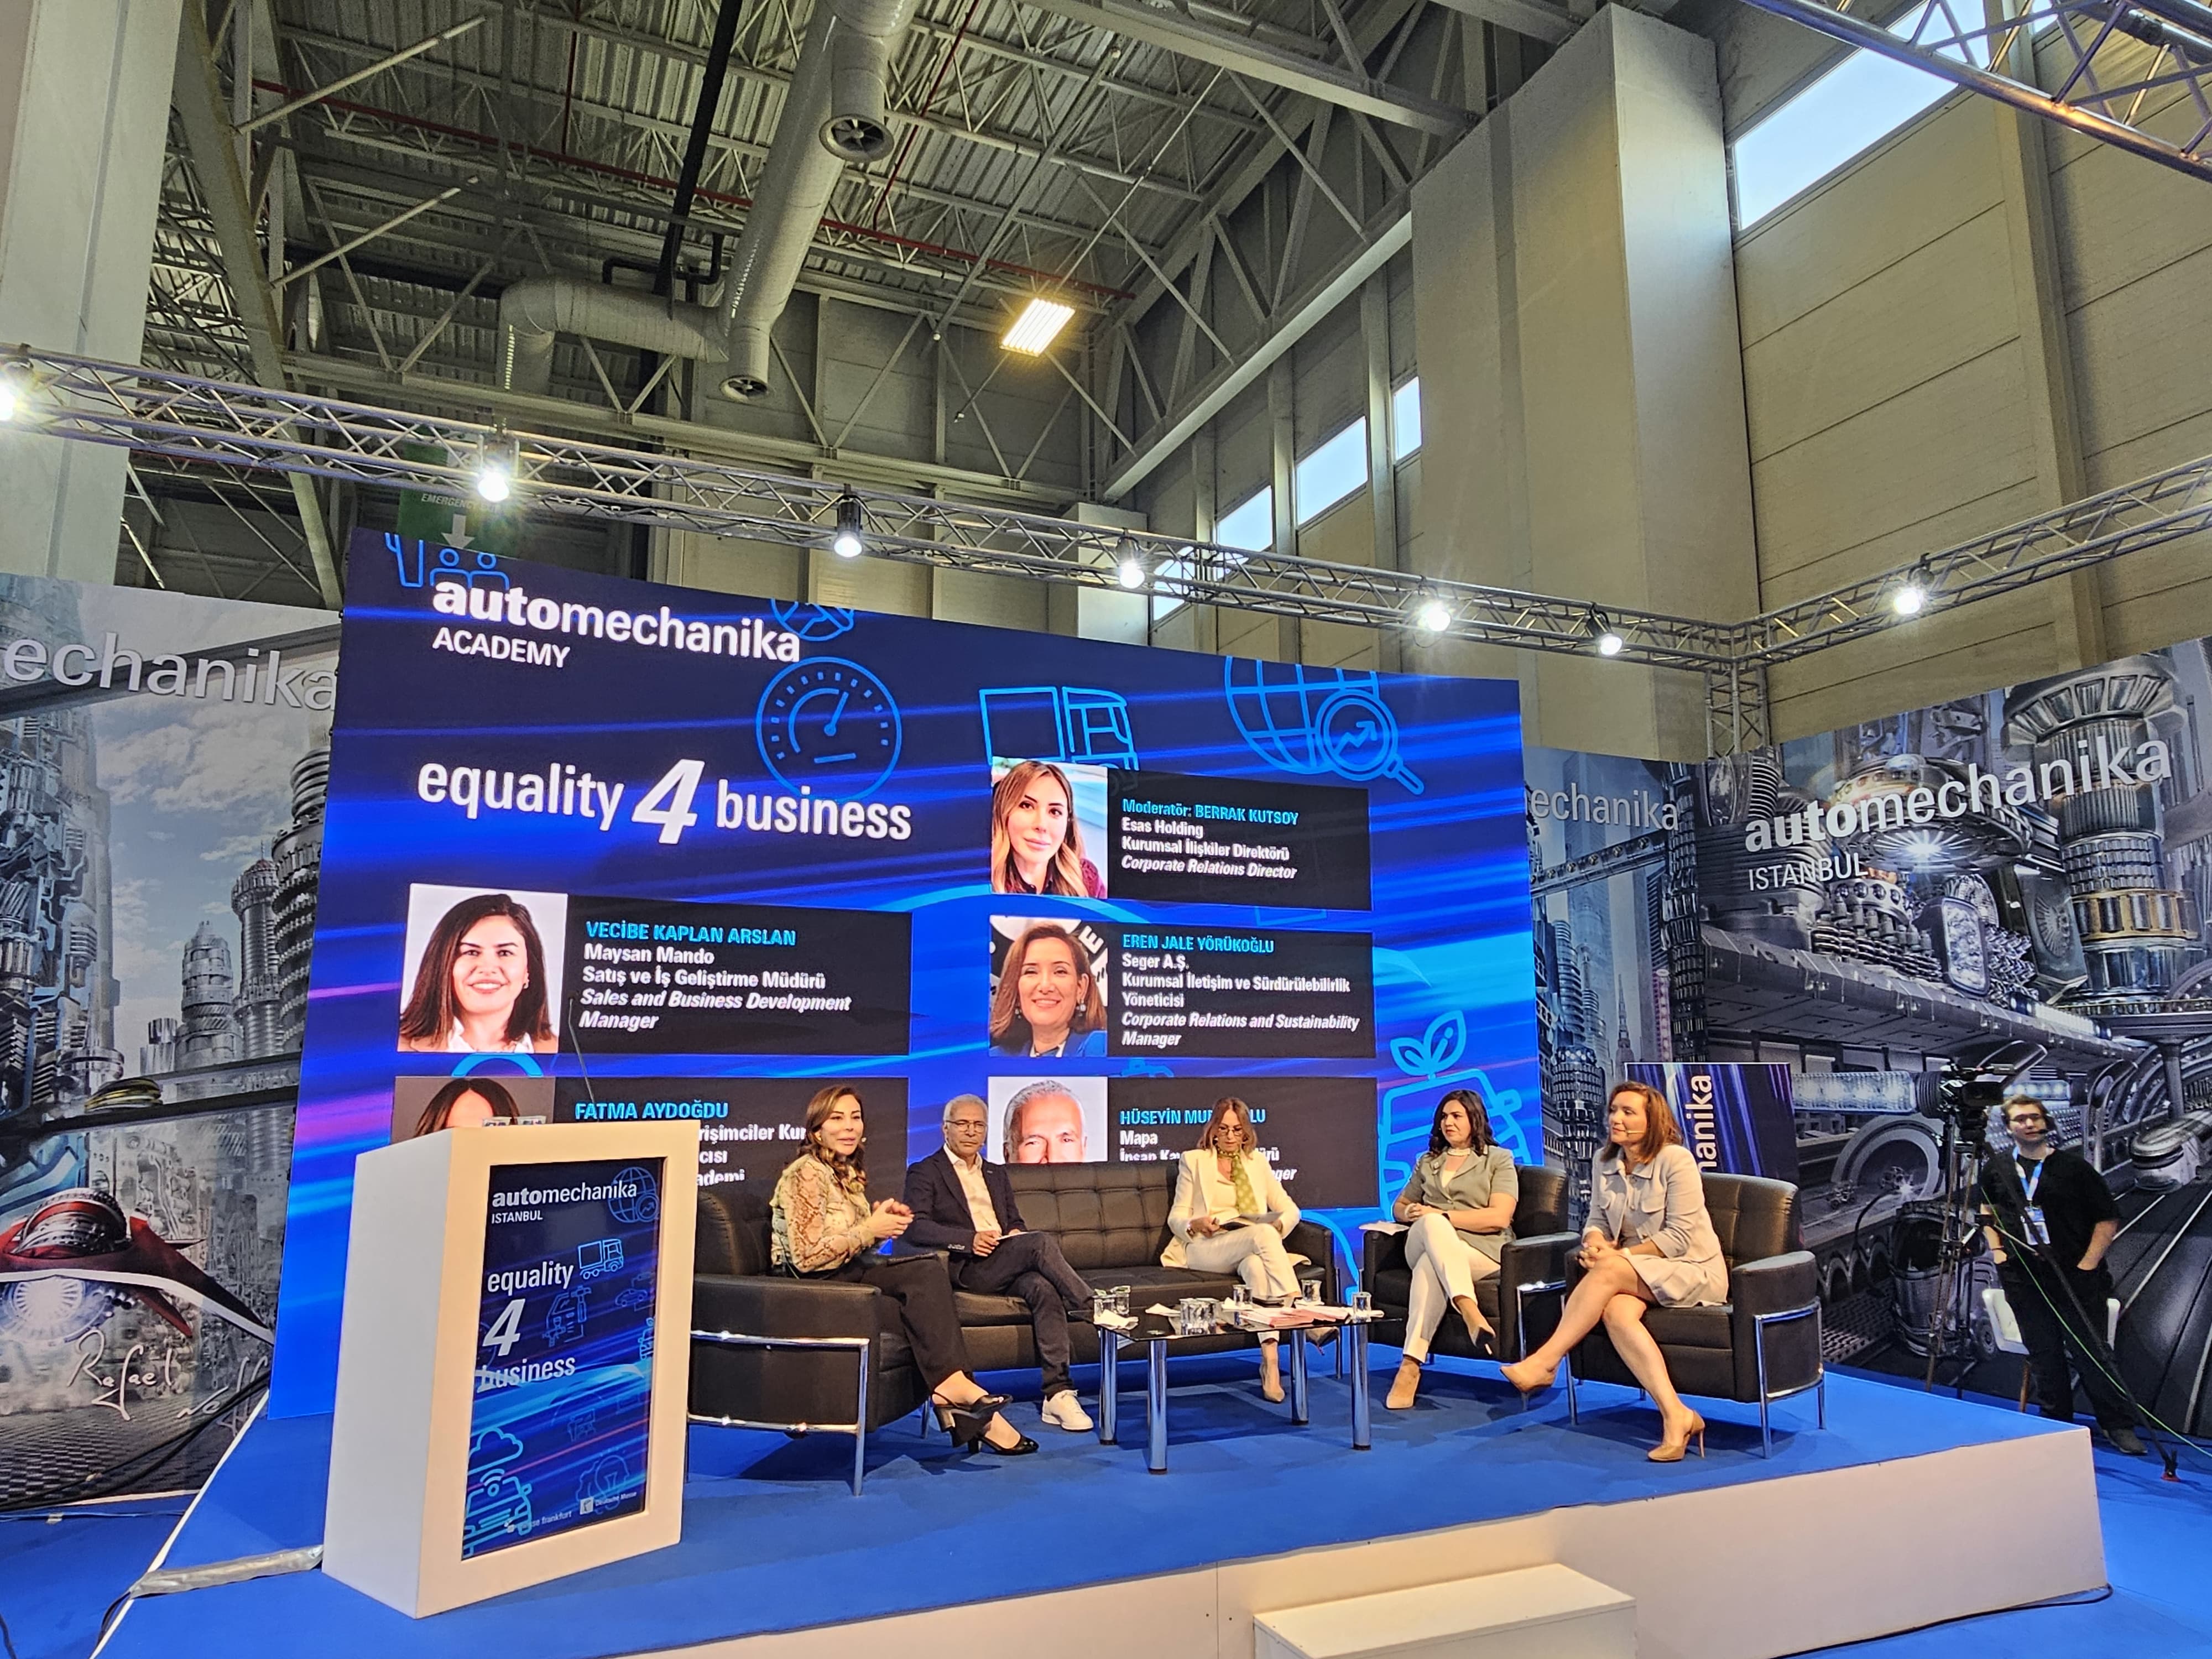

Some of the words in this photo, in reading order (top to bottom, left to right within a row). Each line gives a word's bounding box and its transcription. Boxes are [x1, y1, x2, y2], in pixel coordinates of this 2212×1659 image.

[432, 580, 800, 662] automechanika
[432, 627, 570, 669] ACADEMY
[3, 632, 337, 712] echanika
[417, 761, 624, 832] equality
[630, 758, 706, 844] 4
[716, 779, 912, 841] business
[1745, 735, 2172, 853] automechanika
[1195, 804, 1245, 822] BERRAK
[1249, 809, 1299, 825] KUTSOY
[1530, 782, 1679, 831] echanika
[1155, 819, 1204, 839] Holding
[1121, 836, 1182, 854] Kurumsal
[1233, 844, 1290, 861] Direktörü
[1121, 855, 1185, 873] Corporate
[1187, 860, 1245, 877] Relations
[1246, 864, 1297, 879] Director
[1747, 852, 1869, 893] ISTANBUL
[586, 920, 649, 940] VECİBE
[653, 925, 723, 943] KAPLAN
[728, 927, 796, 946] ARSLAN
[1122, 933, 1158, 950] EREN
[1161, 936, 1194, 951] JALE
[583, 943, 651, 964] Maysan
[656, 946, 714, 964] Mando
[1122, 953, 1160, 971] Seger
[582, 966, 626, 987] Satış
[629, 971, 651, 985] ve
[655, 965, 671, 988] İş
[675, 969, 759, 989] Geliştirme
[762, 971, 826, 989] Müdürü
[1122, 972, 1183, 989] Kurumsal
[1186, 972, 1233, 992] İletişim
[1235, 979, 1250, 990] ve
[1253, 975, 1350, 993] Sürdürülebilirlik
[580, 988, 629, 1006] Sales
[631, 990, 667, 1007] and
[668, 990, 743, 1009] Business
[746, 992, 852, 1014] Development
[1122, 991, 1185, 1008] Yöneticisi
[578, 1010, 659, 1032] Manager
[1121, 1011, 1186, 1029] Corporate
[1189, 1013, 1248, 1029] Relations
[1249, 1014, 1274, 1029] and
[1275, 1015, 1360, 1032] Sustainability
[1121, 1030, 1181, 1049] Manager
[575, 1102, 638, 1120] FATMA
[642, 1099, 729, 1120] AYDOĞDU
[1120, 1107, 1181, 1125] HÜSEYİN
[1120, 1130, 1158, 1147] Mapa
[492, 1180, 637, 1208] automechanika
[491, 1210, 544, 1224] ISTANBUL
[487, 1260, 575, 1296] equality
[482, 1298, 526, 1357] 4
[477, 1357, 576, 1394] business
